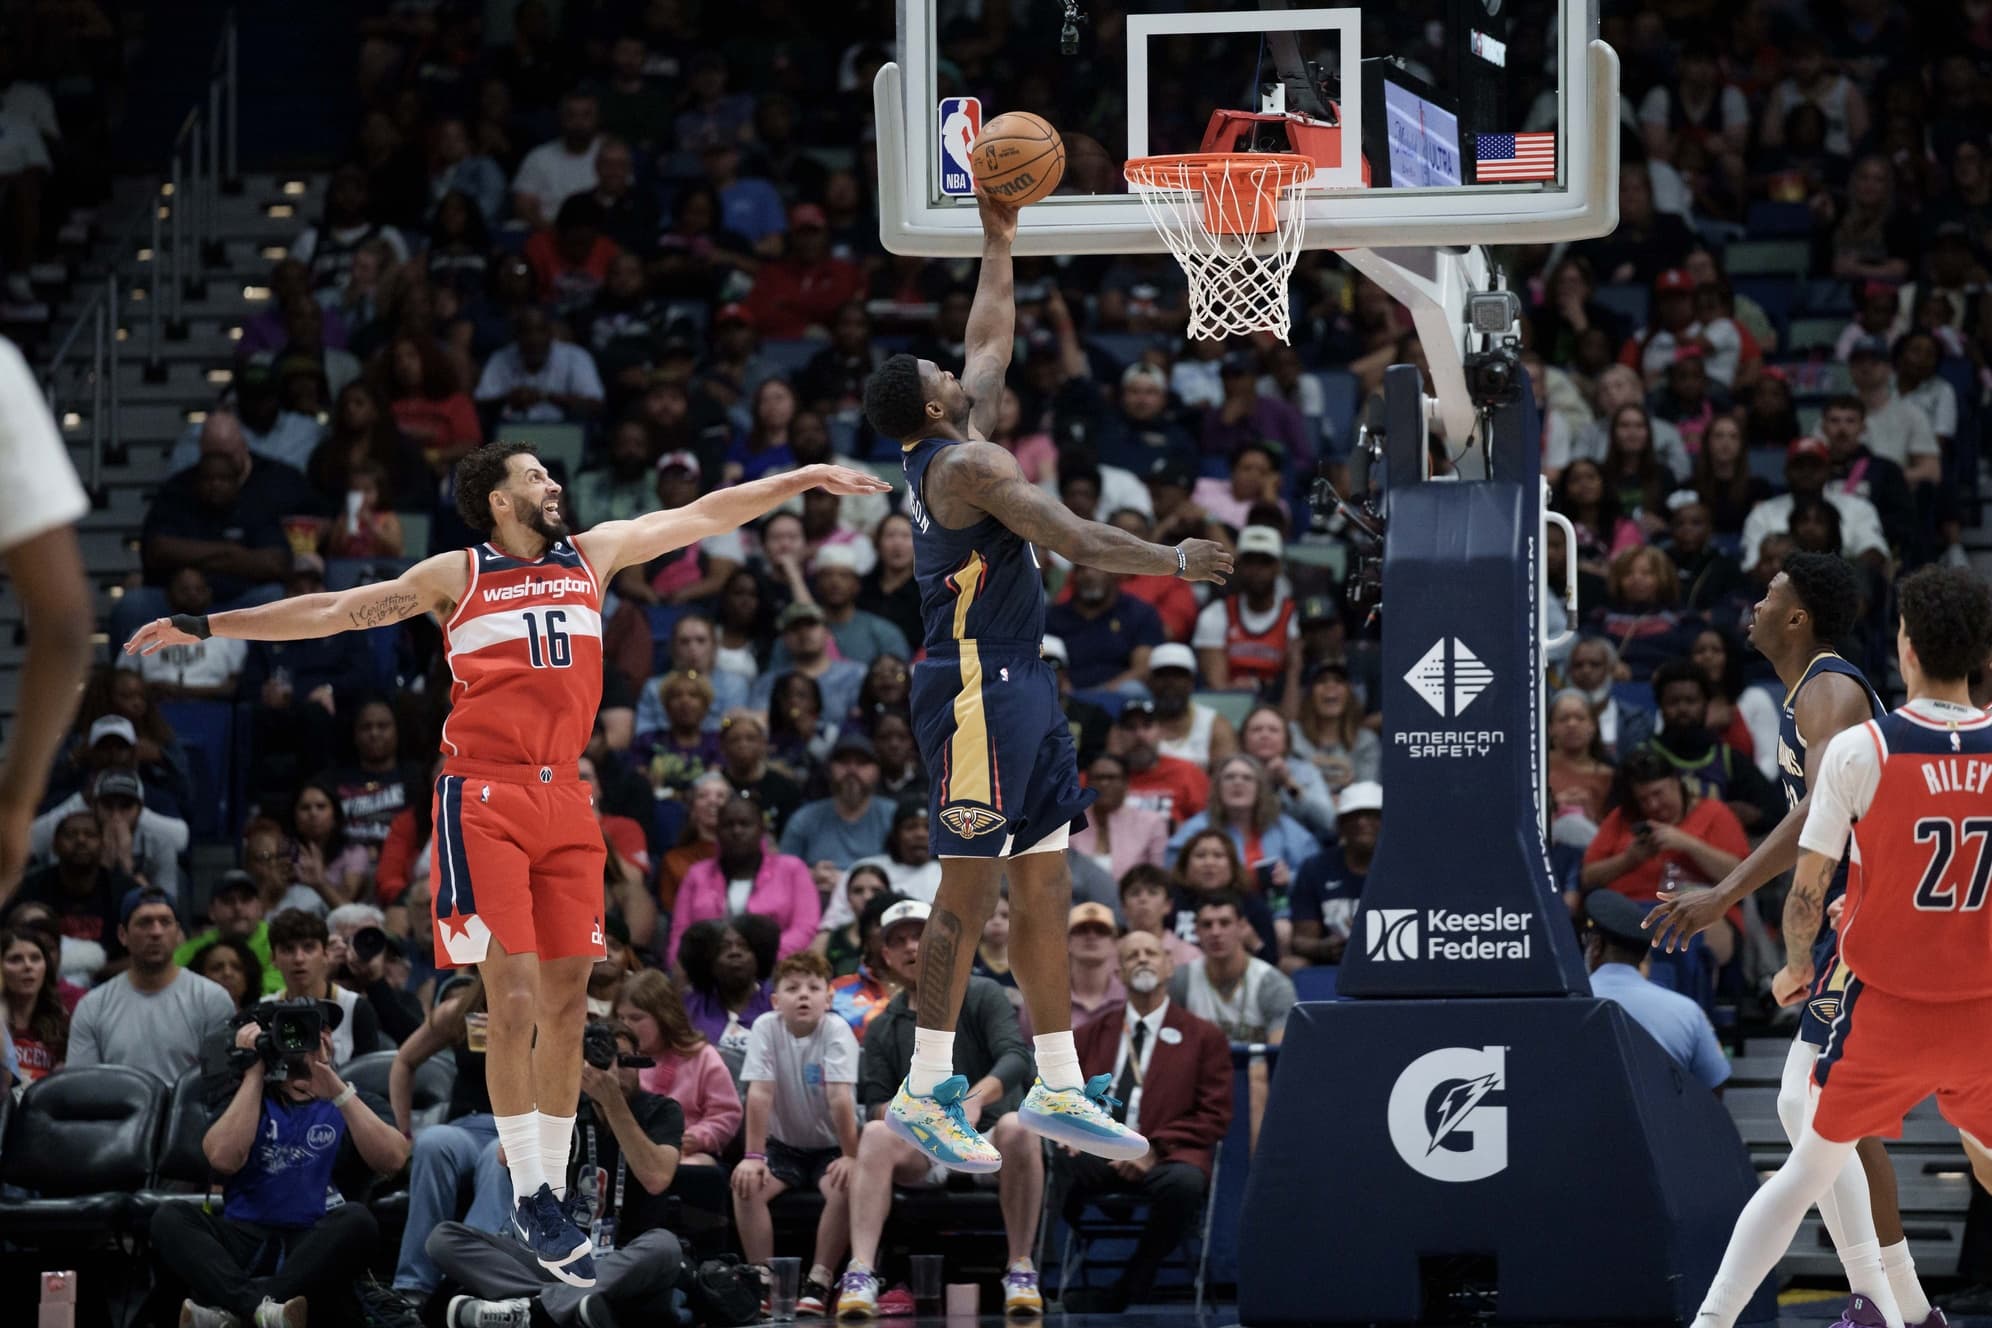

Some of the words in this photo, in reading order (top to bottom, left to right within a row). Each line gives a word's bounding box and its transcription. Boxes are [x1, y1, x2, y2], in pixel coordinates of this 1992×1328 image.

[946, 173, 966, 189] NBA
[483, 576, 591, 602] washington
[522, 610, 573, 668] 16
[1395, 731, 1504, 744] AMERICAN
[1409, 745, 1490, 758] SAFETY
[1921, 759, 1992, 796] RILEY
[1913, 816, 1992, 912] 27
[1428, 907, 1532, 932] Keesler
[1428, 935, 1531, 960] Federal
